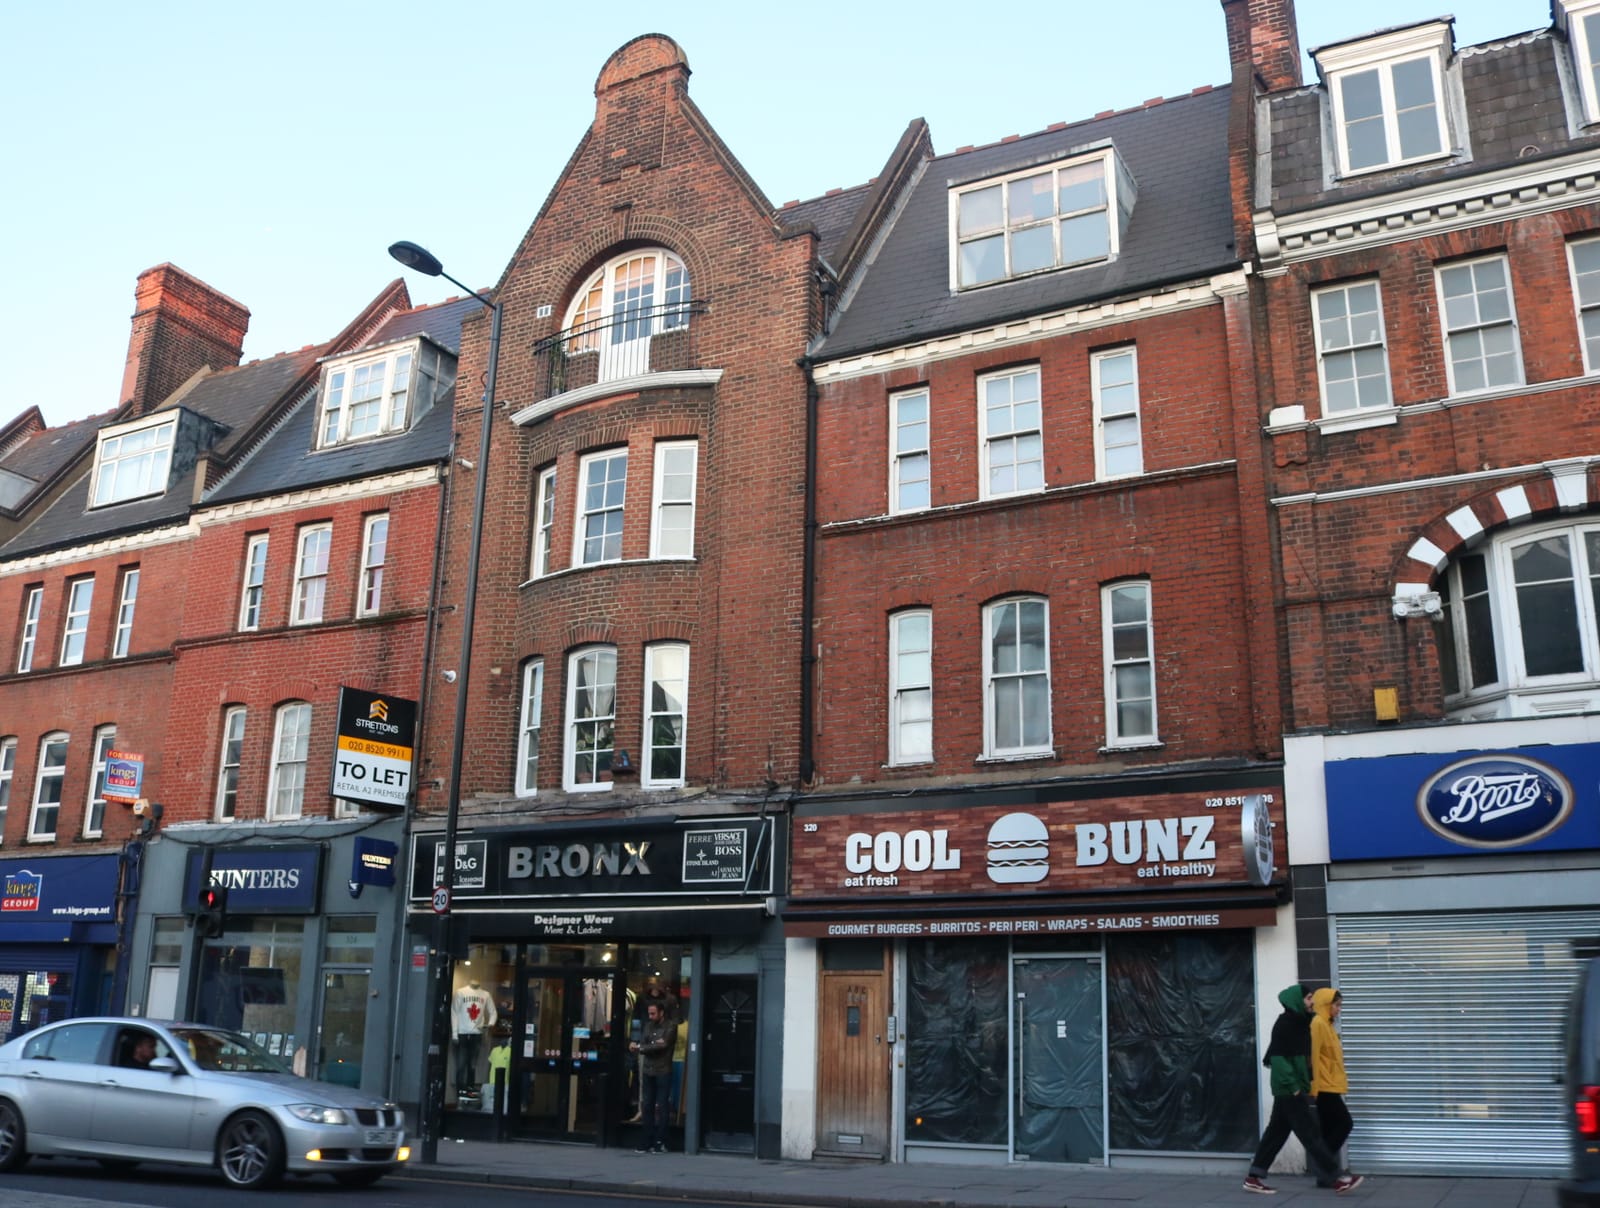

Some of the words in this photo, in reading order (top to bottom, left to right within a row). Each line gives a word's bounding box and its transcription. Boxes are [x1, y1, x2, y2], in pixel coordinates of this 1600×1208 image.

[355, 718, 399, 734] STRETTONS
[348, 741, 363, 751] 020
[366, 744, 385, 755] 8520
[386, 747, 405, 758] 9911
[110, 765, 136, 779] kings
[339, 761, 366, 779] TO
[373, 767, 408, 787] LET
[109, 778, 135, 786] GROUP
[336, 782, 360, 792] RETAIL
[362, 786, 372, 794] A2
[373, 788, 405, 800] PREMISES
[1205, 798, 1223, 807] 020
[1441, 772, 1542, 824] Boots
[803, 823, 817, 832] 320
[714, 831, 741, 841] VERSACE
[715, 846, 742, 855] BOSS
[845, 829, 960, 873] COOL
[1075, 815, 1216, 866] BUNZ
[455, 857, 477, 870] D&G
[507, 841, 651, 879] BRONX
[1137, 867, 1160, 878] eat
[1162, 863, 1216, 876] healthy
[844, 876, 864, 887] eat
[867, 874, 898, 886] fresh
[3, 899, 35, 908] GROUP
[434, 894, 447, 905] 20
[534, 915, 582, 926] Designer
[583, 915, 614, 924] Wear
[828, 924, 875, 935] GOURMET
[877, 923, 922, 934] BURGERS
[930, 922, 980, 933] BURRITOS
[989, 921, 1013, 932] PERI
[1015, 920, 1038, 931] PERI
[1047, 919, 1088, 930] WRAPS
[1097, 917, 1142, 929] SALADS
[1152, 914, 1219, 927] SMOOTHIES
